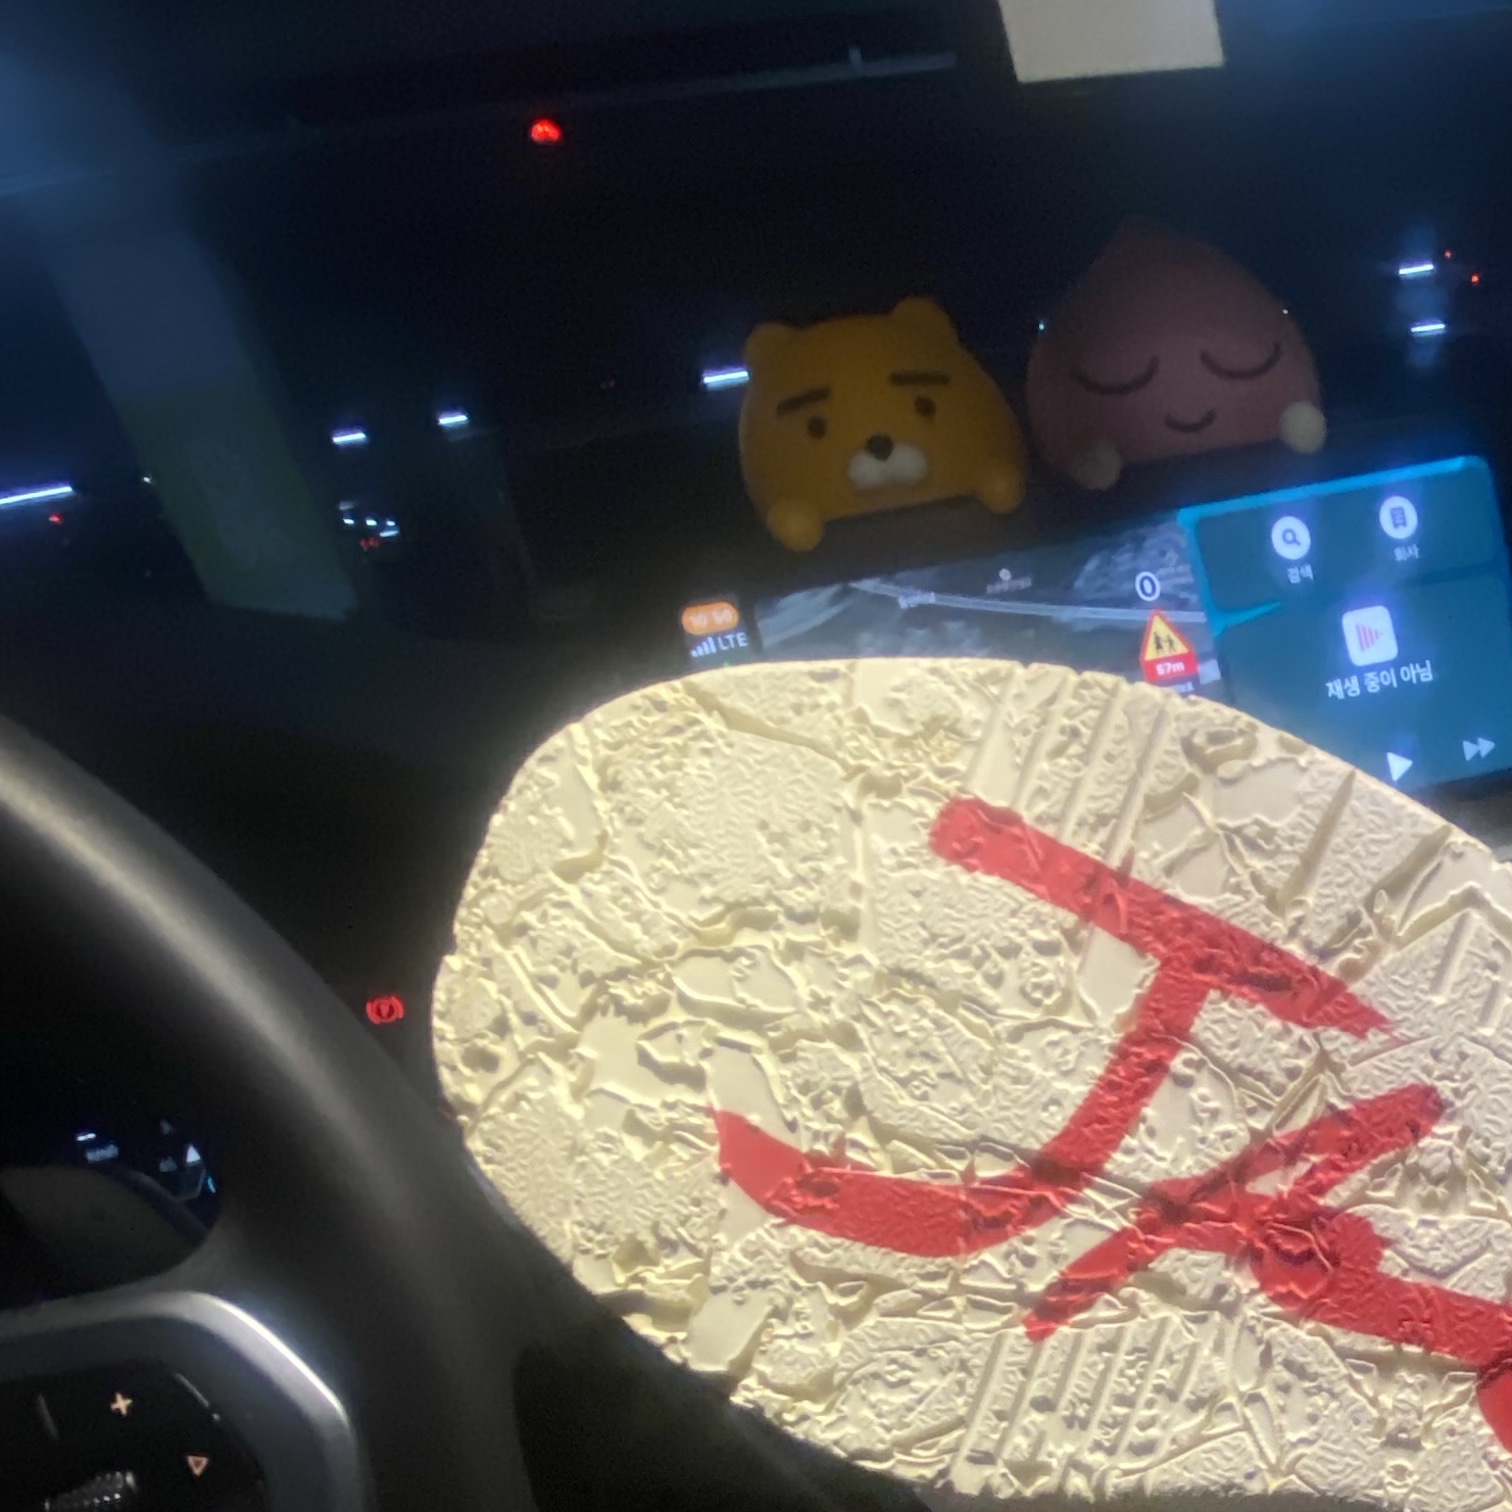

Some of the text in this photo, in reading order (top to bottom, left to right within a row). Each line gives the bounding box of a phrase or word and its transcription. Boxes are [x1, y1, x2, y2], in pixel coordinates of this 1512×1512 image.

[1287, 564, 1313, 584] 검색
[717, 632, 748, 651] LTE
[1326, 659, 1434, 699] 재생 중이 아님
